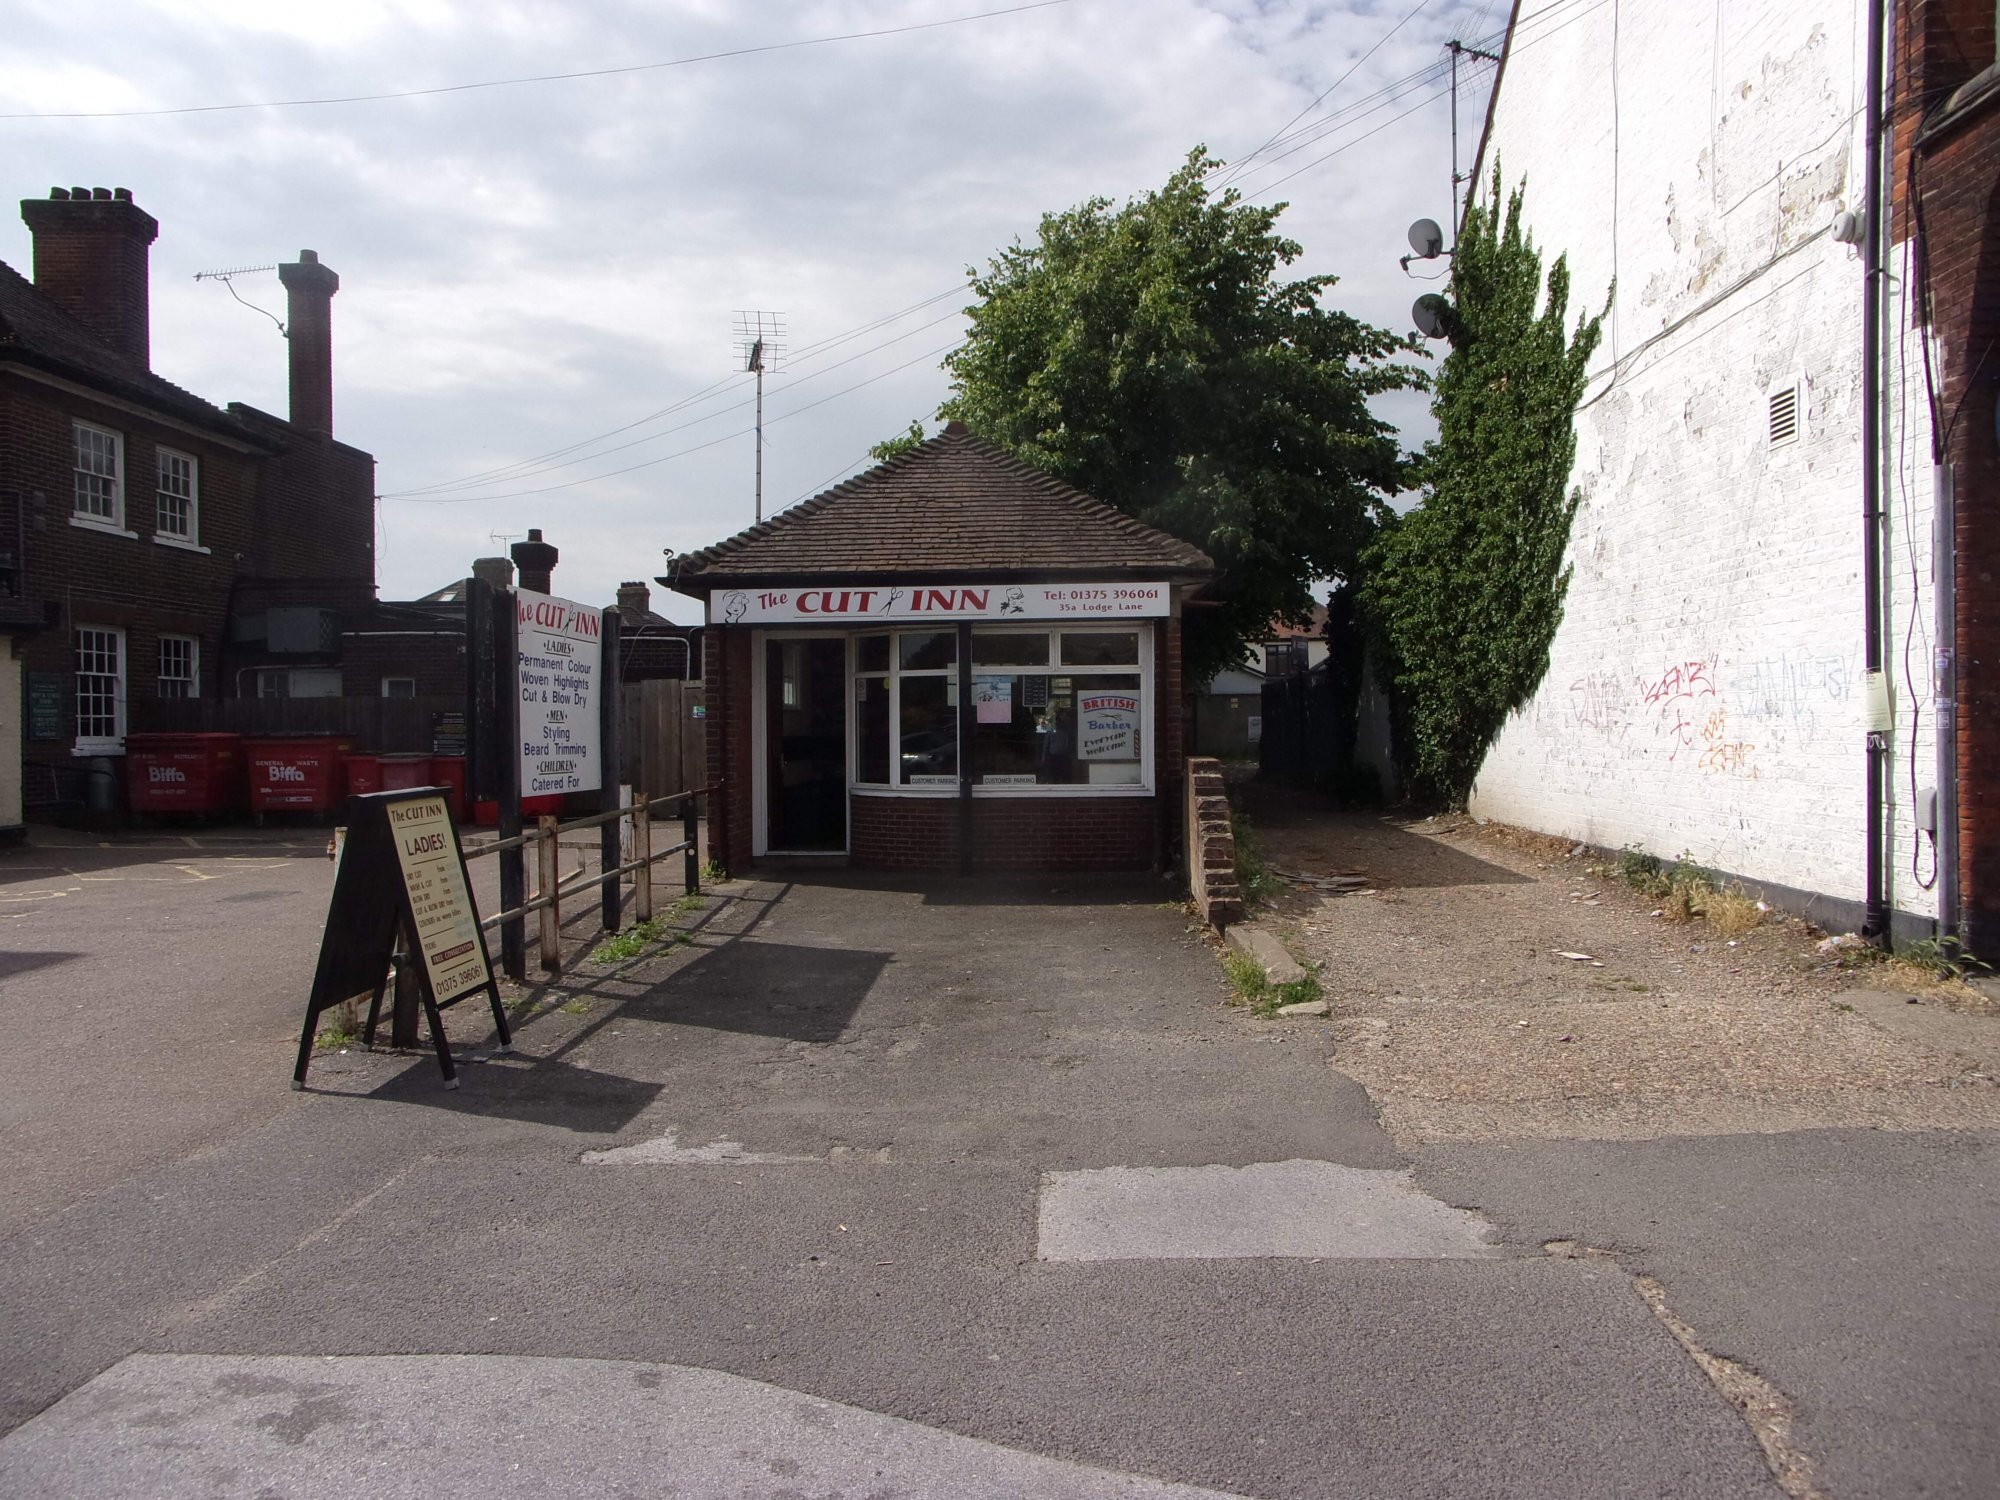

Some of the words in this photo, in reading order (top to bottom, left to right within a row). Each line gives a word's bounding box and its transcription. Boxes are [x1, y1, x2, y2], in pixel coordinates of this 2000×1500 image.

[758, 592, 789, 610] The
[795, 591, 878, 614] CUT
[910, 589, 991, 611] INN
[1044, 591, 1066, 600] Tel:
[1070, 590, 1107, 600] 01375
[1113, 589, 1158, 599] 396061
[1059, 603, 1077, 611] 35a
[1083, 603, 1113, 612] Lodge
[1119, 603, 1143, 611] Lane
[517, 600, 534, 625] he
[535, 602, 566, 629] CUT
[575, 612, 600, 637] INN
[518, 652, 563, 671] Permanent
[568, 660, 592, 675] Colour
[521, 670, 549, 686] Woven
[554, 674, 589, 692] Highlights
[522, 688, 538, 701] Cut
[542, 690, 548, 703] &
[552, 691, 571, 705] Blow
[574, 693, 587, 708] Dry
[1083, 698, 1136, 710] BRITISH
[1087, 720, 1131, 730] Barber
[543, 726, 570, 742] Styling
[524, 743, 549, 756] Beard
[554, 743, 587, 758] Trimming
[149, 766, 185, 782] Biffa
[269, 765, 305, 781] Biffa
[532, 777, 564, 791] Catered
[568, 775, 580, 788] For
[391, 809, 405, 823] The
[406, 806, 424, 820] CUT
[426, 803, 442, 817] INN
[404, 832, 447, 857] LADIES!
[436, 975, 458, 995] 01375
[459, 965, 483, 985] 396061
